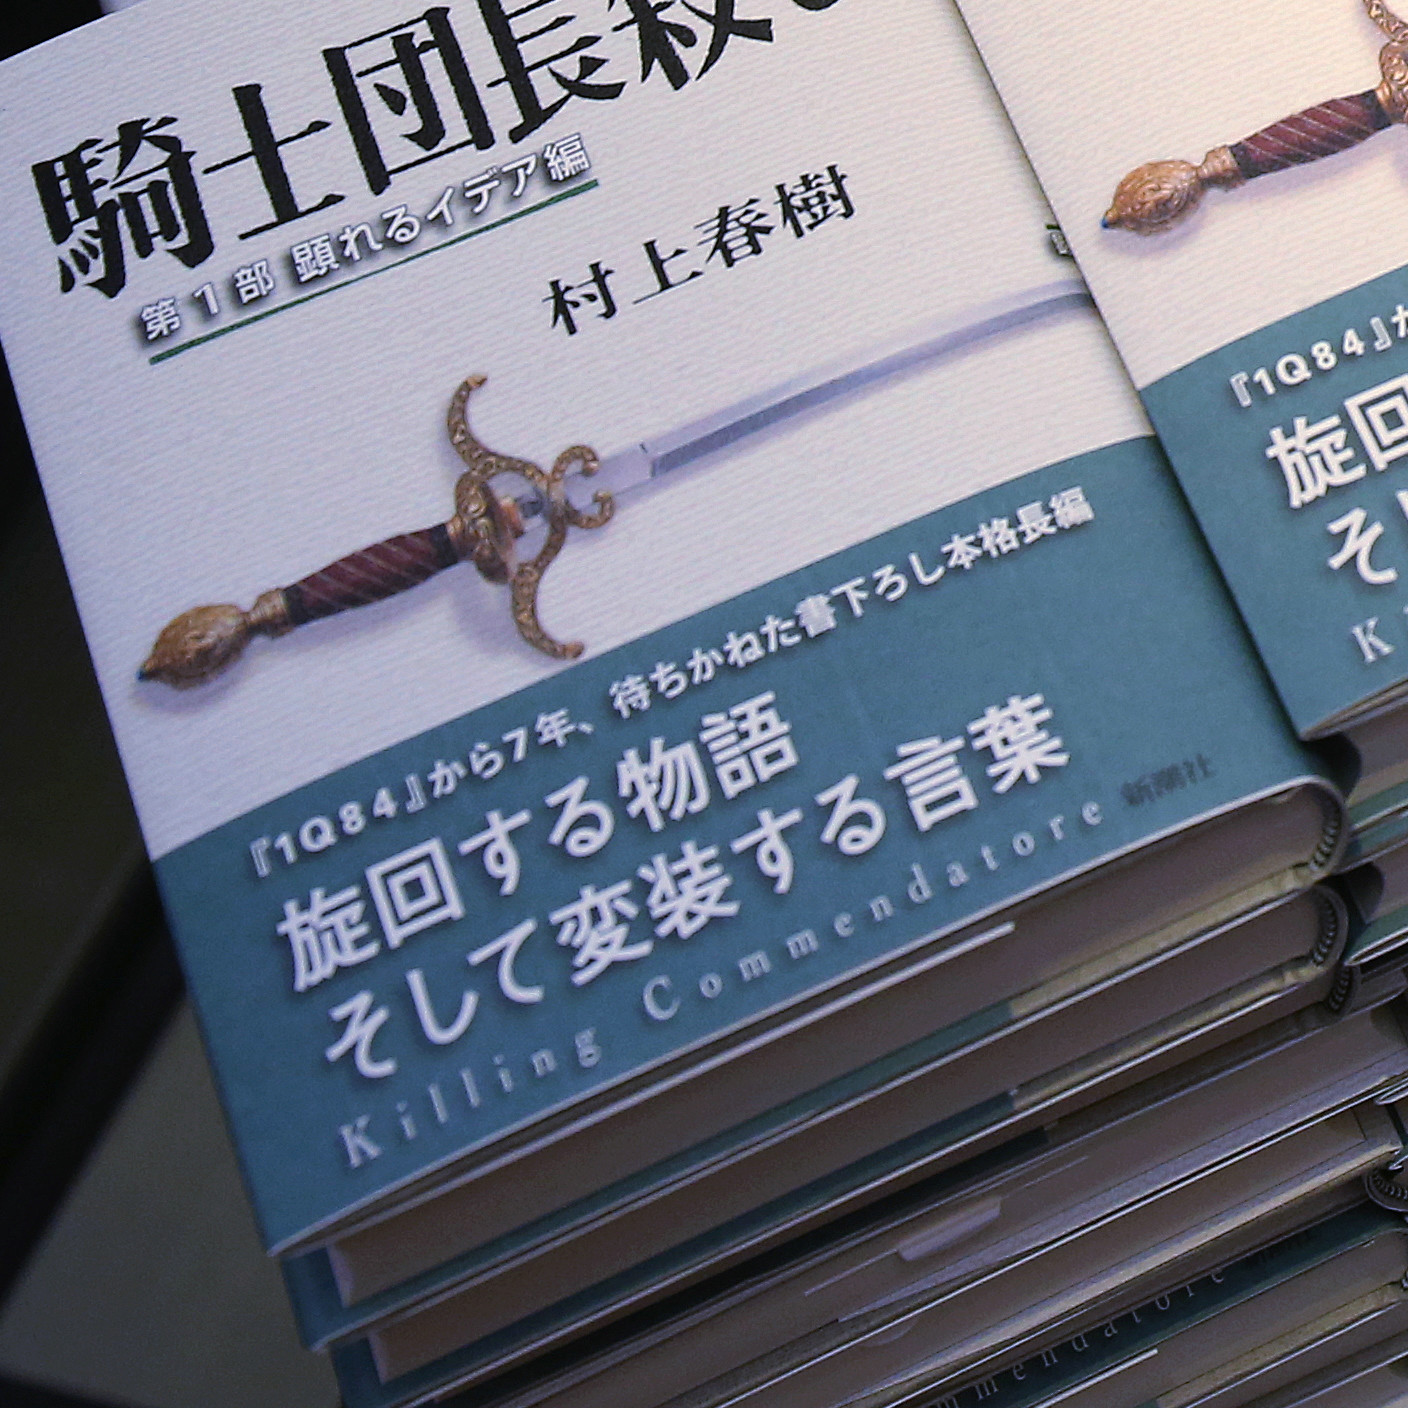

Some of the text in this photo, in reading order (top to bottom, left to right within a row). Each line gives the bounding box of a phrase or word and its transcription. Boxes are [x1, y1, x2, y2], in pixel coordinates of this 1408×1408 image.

[139, 131, 593, 344] 第1部 顕れるイデア編
[546, 163, 859, 336] 村上春樹
[275, 693, 803, 996] 旋回する物語
[323, 694, 1073, 1084] そして変装する言葉
[339, 797, 1106, 1169] Killing Commendatore
